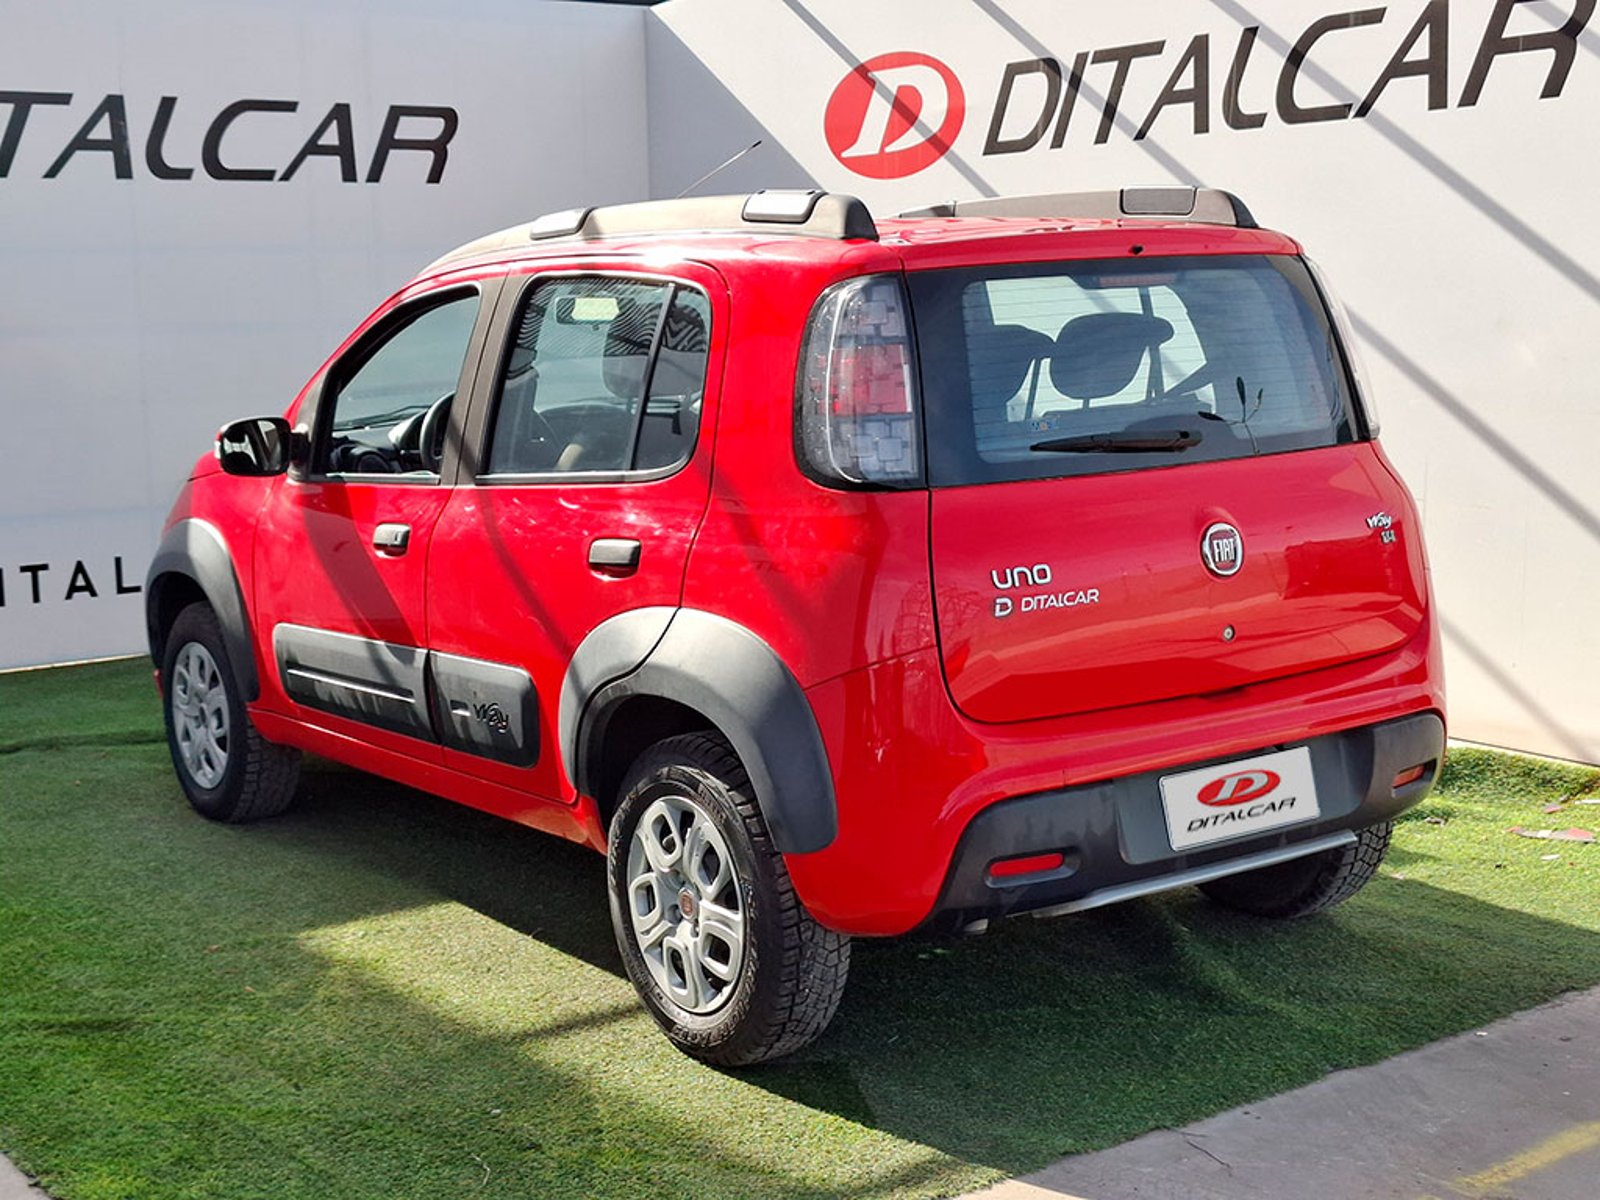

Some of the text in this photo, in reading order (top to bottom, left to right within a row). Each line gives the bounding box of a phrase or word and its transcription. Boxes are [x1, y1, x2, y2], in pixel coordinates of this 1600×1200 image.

[982, 0, 1598, 157] DITALCAR
[1211, 537, 1238, 563] FIAT
[1020, 588, 1100, 612] DITALCAR
[1186, 796, 1297, 833] DITALCAR
